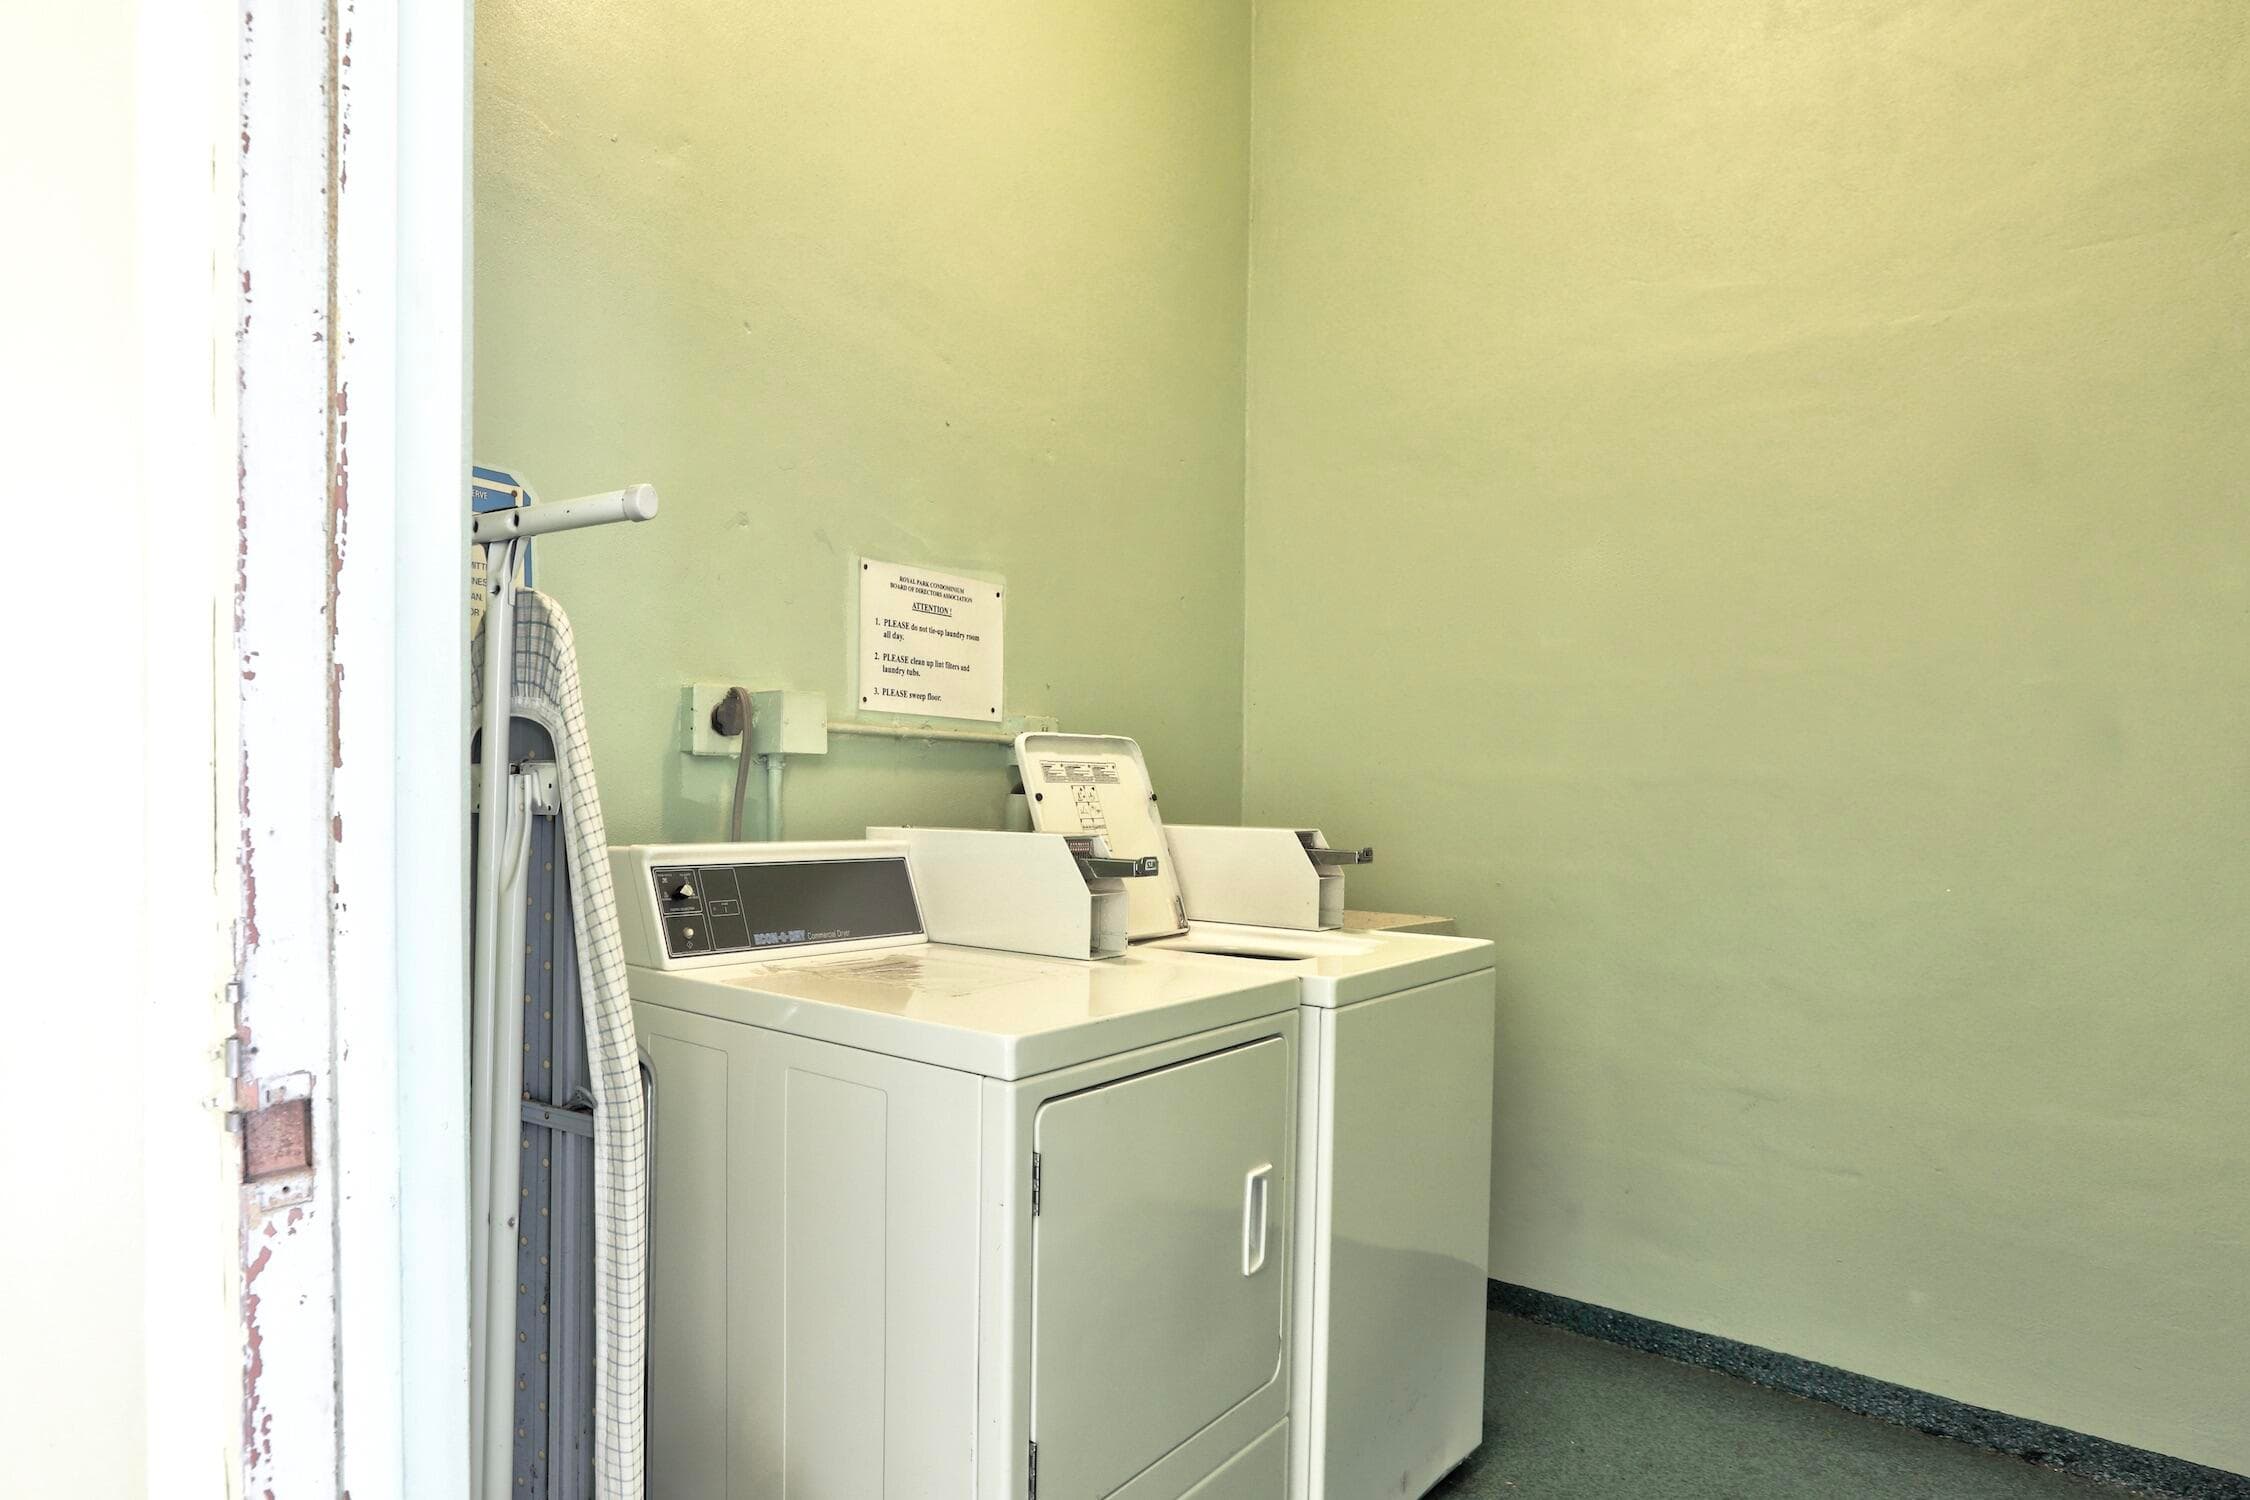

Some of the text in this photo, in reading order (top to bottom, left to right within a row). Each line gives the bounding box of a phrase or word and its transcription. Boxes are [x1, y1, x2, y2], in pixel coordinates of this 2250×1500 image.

[890, 582, 907, 591] BOARD
[915, 587, 942, 598] DIRECTORS
[943, 593, 972, 603] ASSOCIATION
[900, 576, 964, 594] ROYAL PARK CONDOMINIUM
[884, 619, 910, 630] PLEASE
[929, 626, 944, 637] tie-up
[945, 630, 965, 640] laundry
[892, 632, 904, 641] day.
[883, 653, 909, 664] PLEASE
[911, 657, 925, 666] clean
[945, 661, 959, 670] filters
[882, 665, 920, 677] laundry tubs.
[882, 688, 908, 698] PLEASE
[909, 692, 926, 701] sweep
[928, 692, 941, 701] floor.
